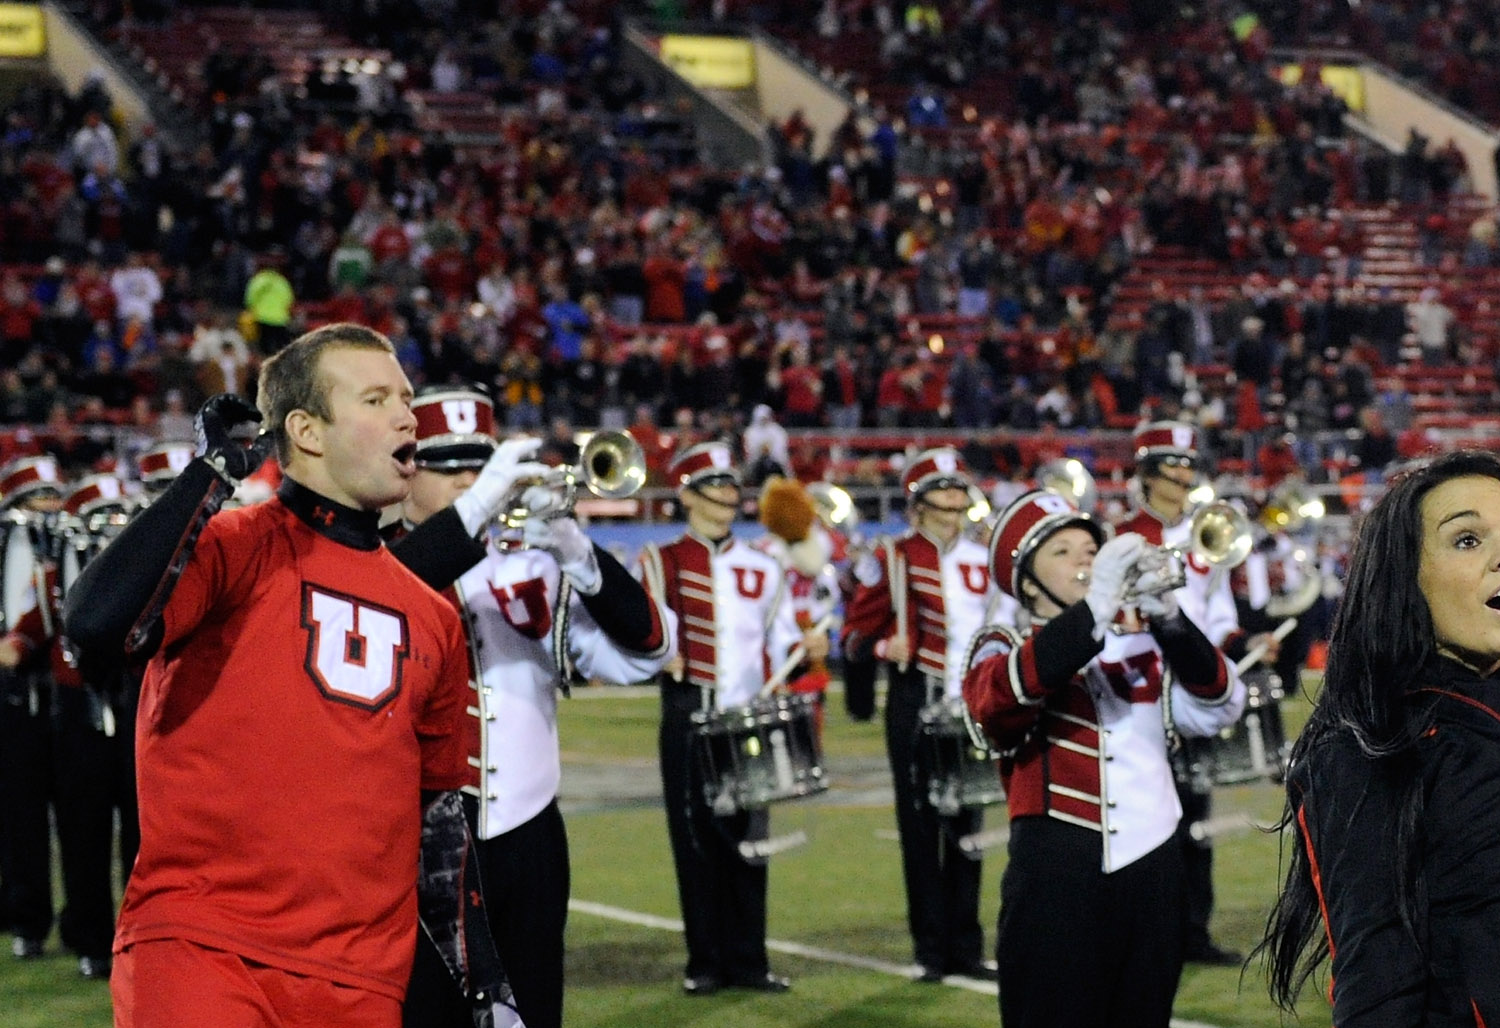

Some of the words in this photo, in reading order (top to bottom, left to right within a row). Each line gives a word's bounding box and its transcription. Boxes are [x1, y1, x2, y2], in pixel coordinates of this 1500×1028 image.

[442, 401, 476, 433] U
[732, 567, 765, 599] U
[958, 564, 989, 594] U
[302, 582, 408, 711] U
